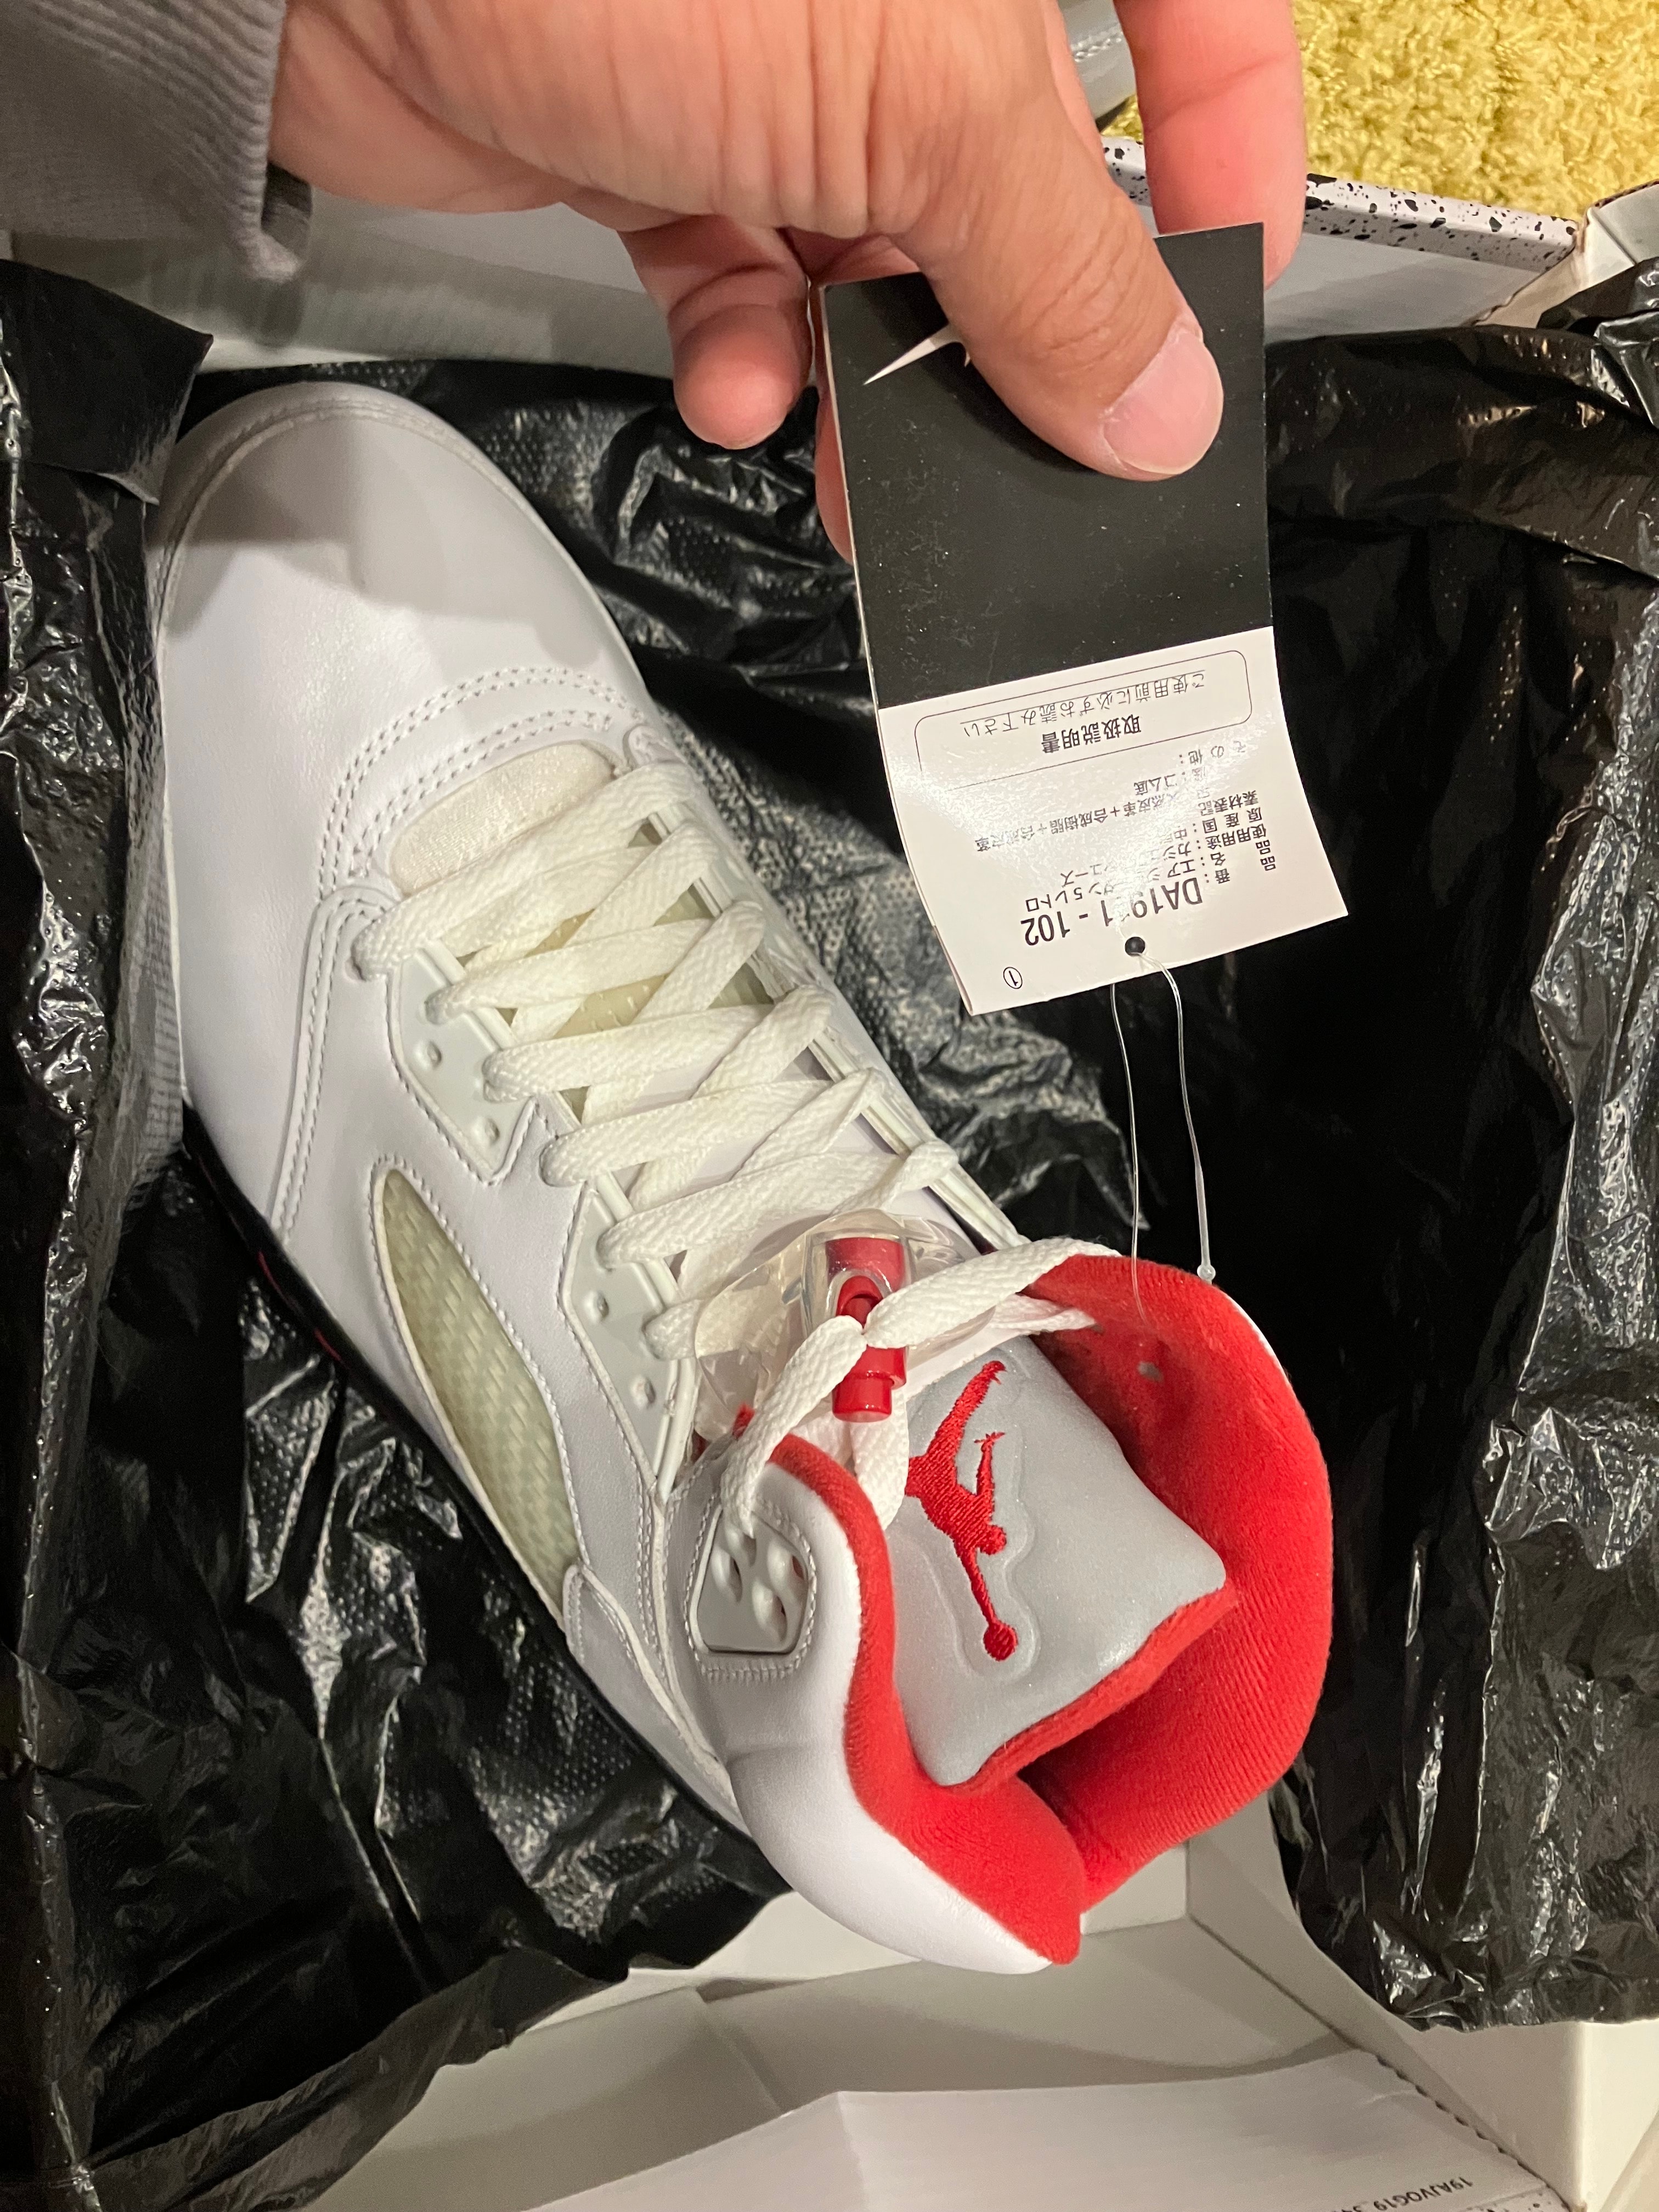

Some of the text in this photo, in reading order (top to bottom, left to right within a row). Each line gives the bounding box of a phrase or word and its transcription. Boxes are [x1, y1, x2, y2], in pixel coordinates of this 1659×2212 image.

[961, 670, 1205, 737] ご使用前に必ずお読み下さい
[1041, 714, 1141, 753] 取扱説明書
[1020, 911, 1070, 946] 102
